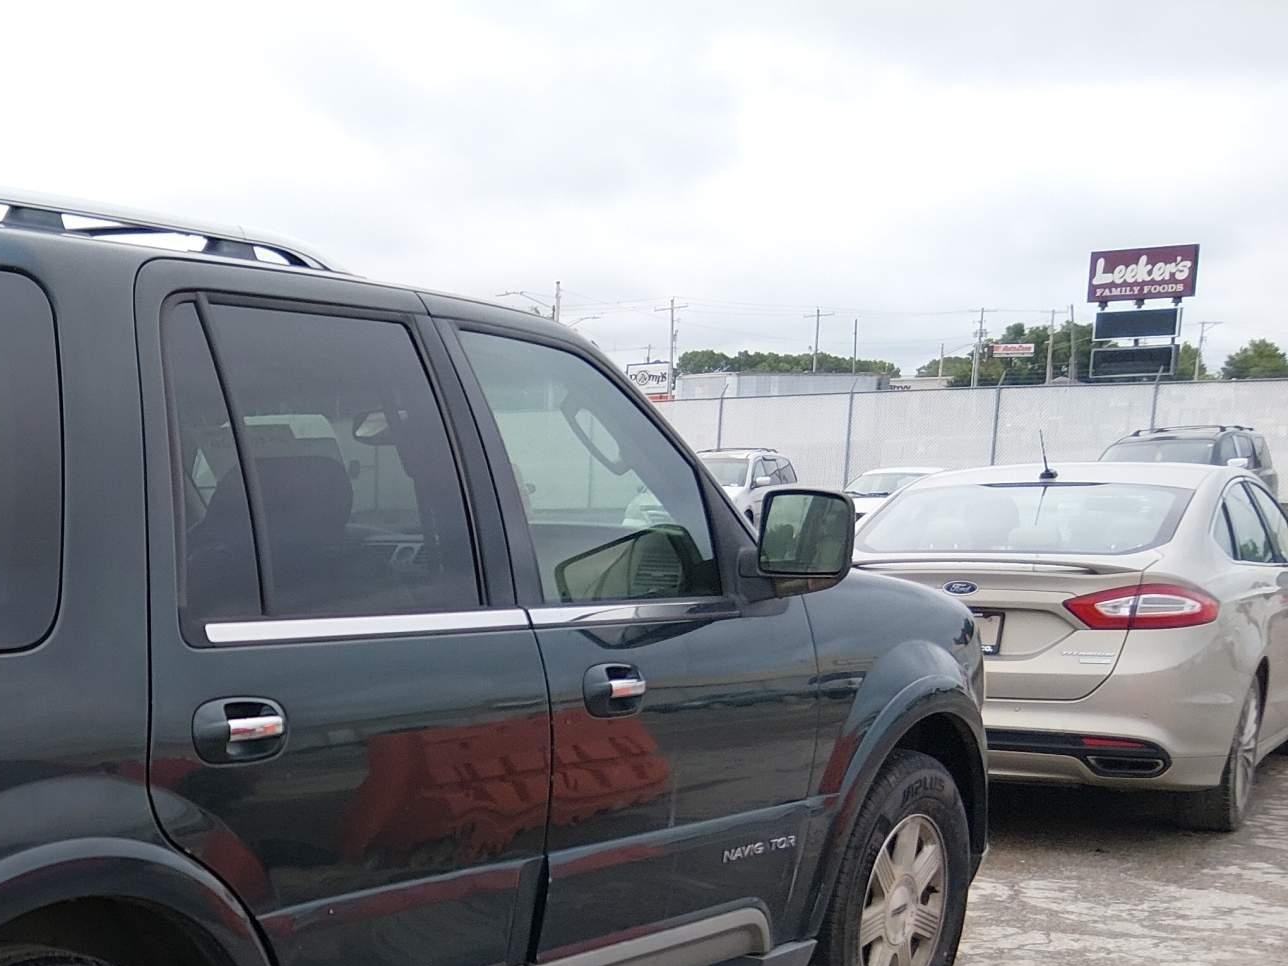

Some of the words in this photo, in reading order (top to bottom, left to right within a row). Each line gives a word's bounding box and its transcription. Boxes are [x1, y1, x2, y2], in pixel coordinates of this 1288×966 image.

[1092, 255, 1192, 285] Leeker's
[1095, 286, 1140, 297] FAMILY
[1143, 283, 1184, 294] FOODS
